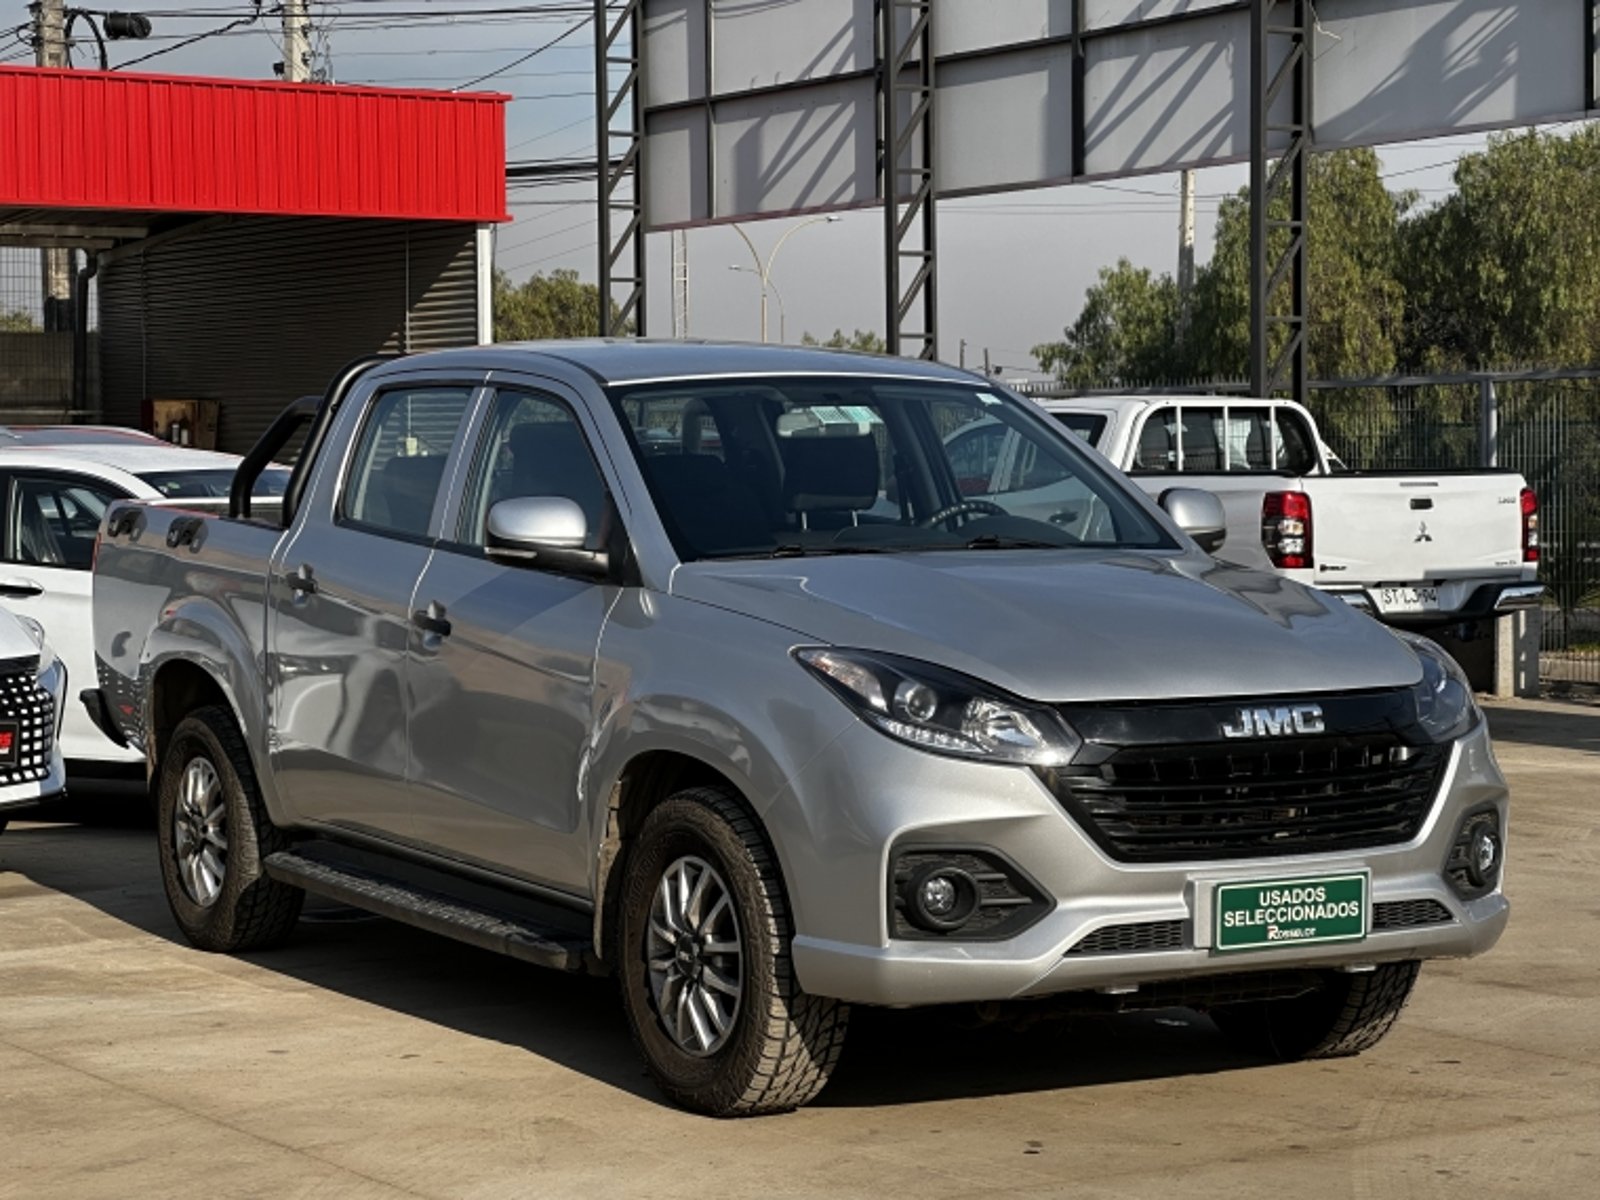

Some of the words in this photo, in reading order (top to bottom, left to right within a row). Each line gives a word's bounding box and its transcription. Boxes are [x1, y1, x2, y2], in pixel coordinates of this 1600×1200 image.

[1222, 705, 1325, 737] JMC
[1259, 887, 1326, 906] USADOS
[1224, 901, 1359, 927] SELECCIONADOS
